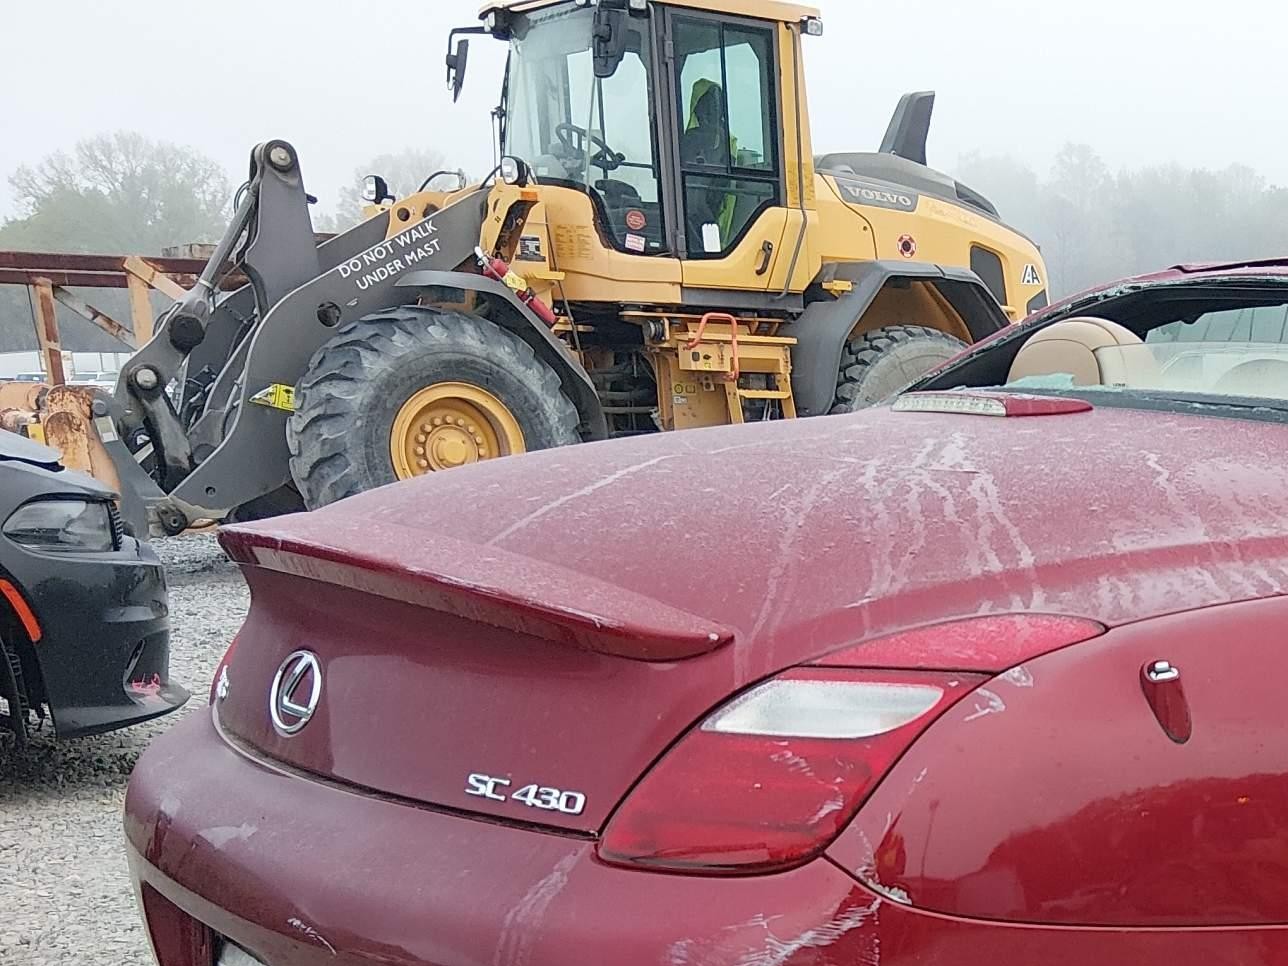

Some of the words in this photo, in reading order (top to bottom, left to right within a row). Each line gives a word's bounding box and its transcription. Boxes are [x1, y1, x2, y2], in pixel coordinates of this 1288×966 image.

[843, 185, 912, 206] VOLVO
[338, 259, 362, 278] DO
[362, 241, 396, 266] NOT
[395, 220, 438, 247] WALK
[356, 259, 405, 290] UNDER
[404, 239, 441, 266] MAST
[464, 773, 511, 802] SC
[511, 784, 586, 814] 430
